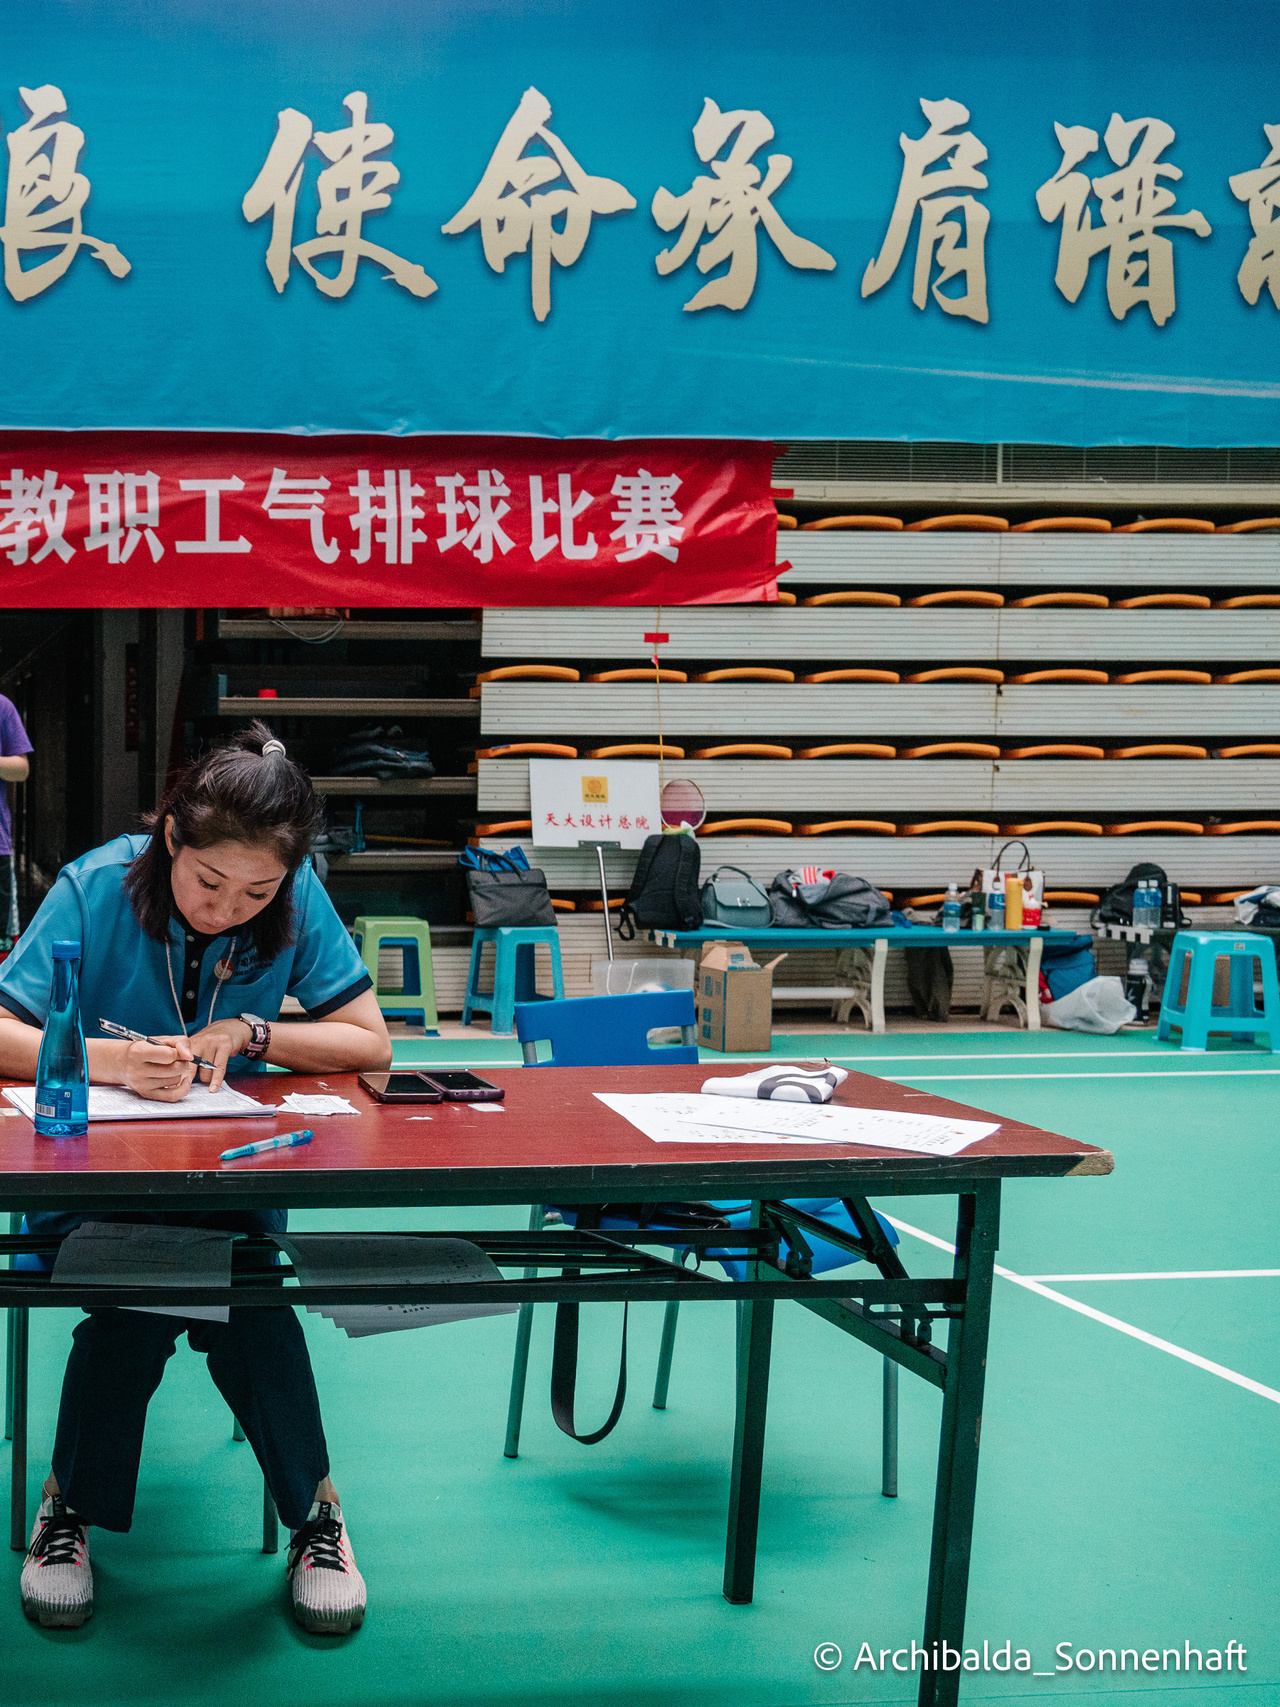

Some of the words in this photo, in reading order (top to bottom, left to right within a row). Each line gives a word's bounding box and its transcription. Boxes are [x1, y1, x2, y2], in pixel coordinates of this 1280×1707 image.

[544, 812, 650, 830] 天大设计总院
